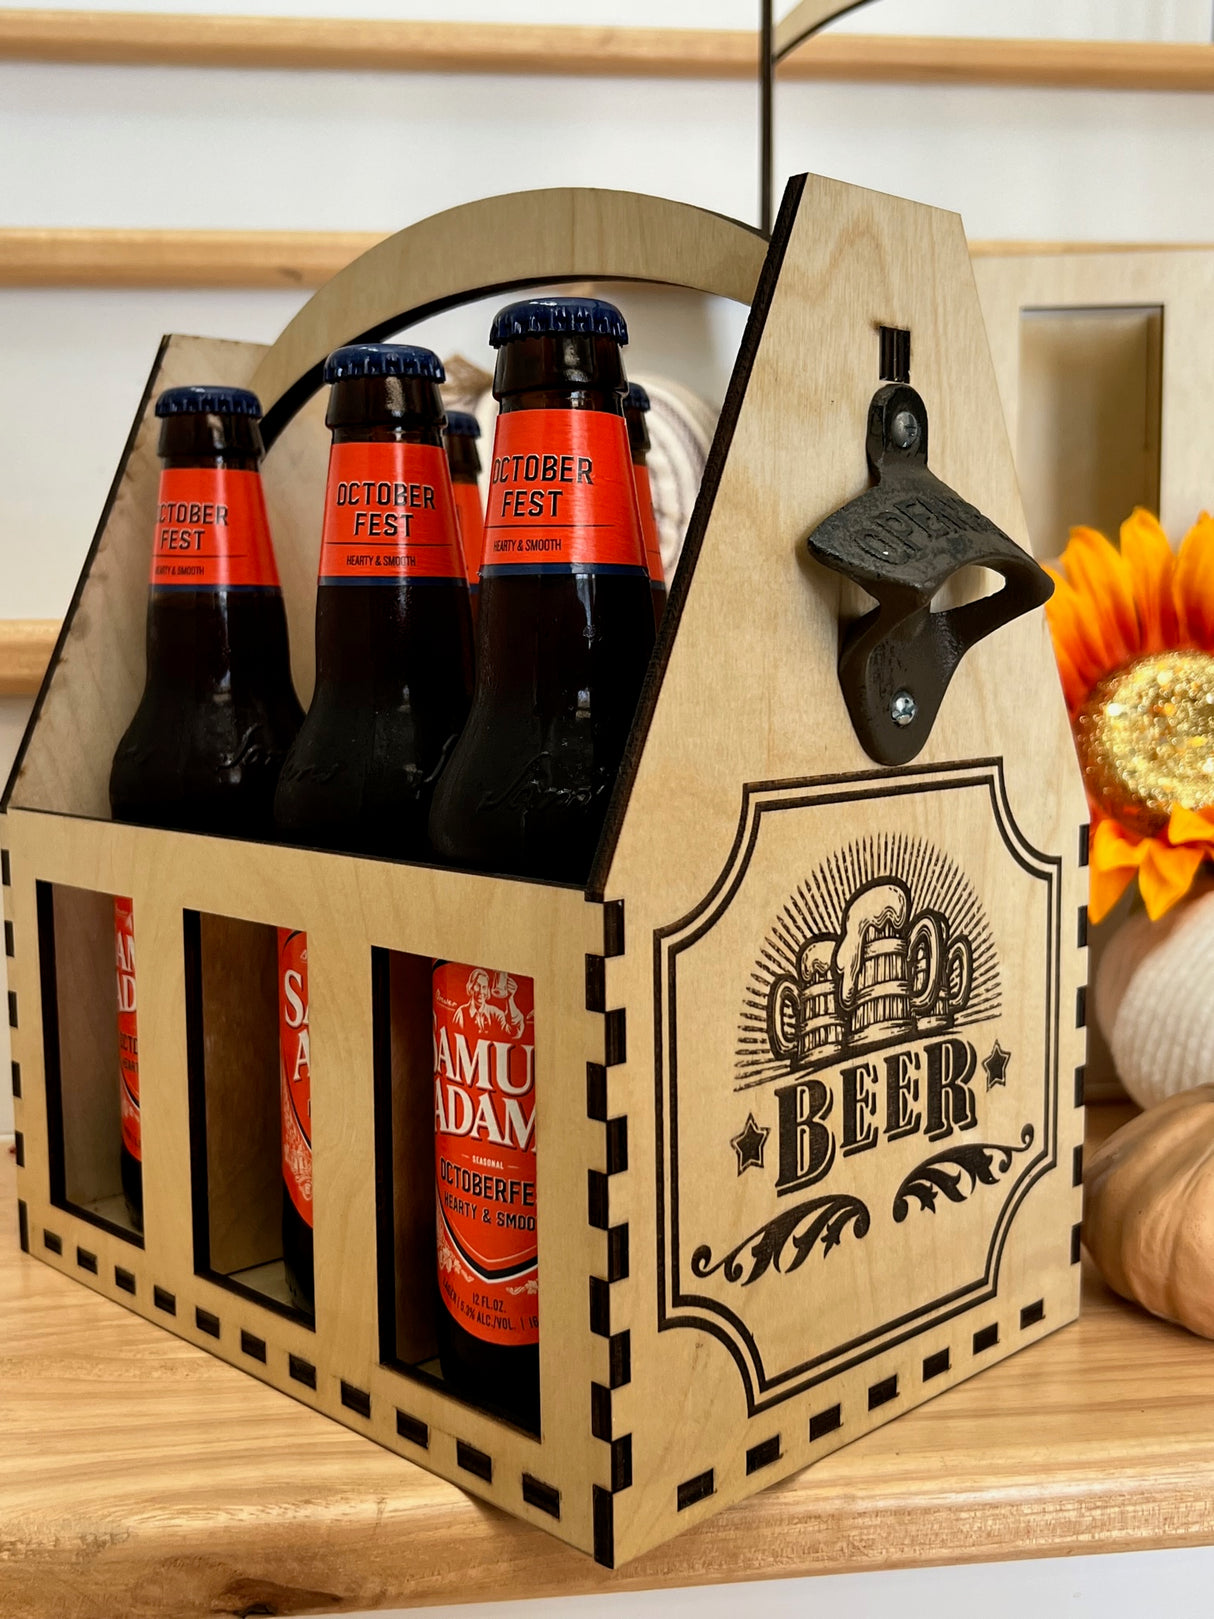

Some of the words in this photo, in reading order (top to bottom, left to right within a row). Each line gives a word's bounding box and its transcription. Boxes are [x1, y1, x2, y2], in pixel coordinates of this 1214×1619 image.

[491, 454, 594, 485] OCTOBER
[336, 481, 436, 510] OCTOBER
[501, 489, 563, 517] FEST
[157, 502, 229, 526] CTOBER
[353, 511, 414, 537] FEST
[160, 528, 206, 550] FEST
[493, 541, 517, 552] HEARTY
[517, 541, 523, 552] &
[525, 539, 562, 552] SMOOTH
[177, 566, 204, 575] SMOOTH
[346, 555, 374, 566] HEARTY
[375, 556, 382, 566] &
[383, 556, 416, 567] SMOOTH
[433, 1026, 535, 1097] AMU
[773, 1038, 978, 1198] BEER
[472, 1155, 504, 1170] SEASONAL
[444, 1191, 478, 1220] HEARTY
[482, 1207, 492, 1224] &
[472, 1292, 480, 1306] 12
